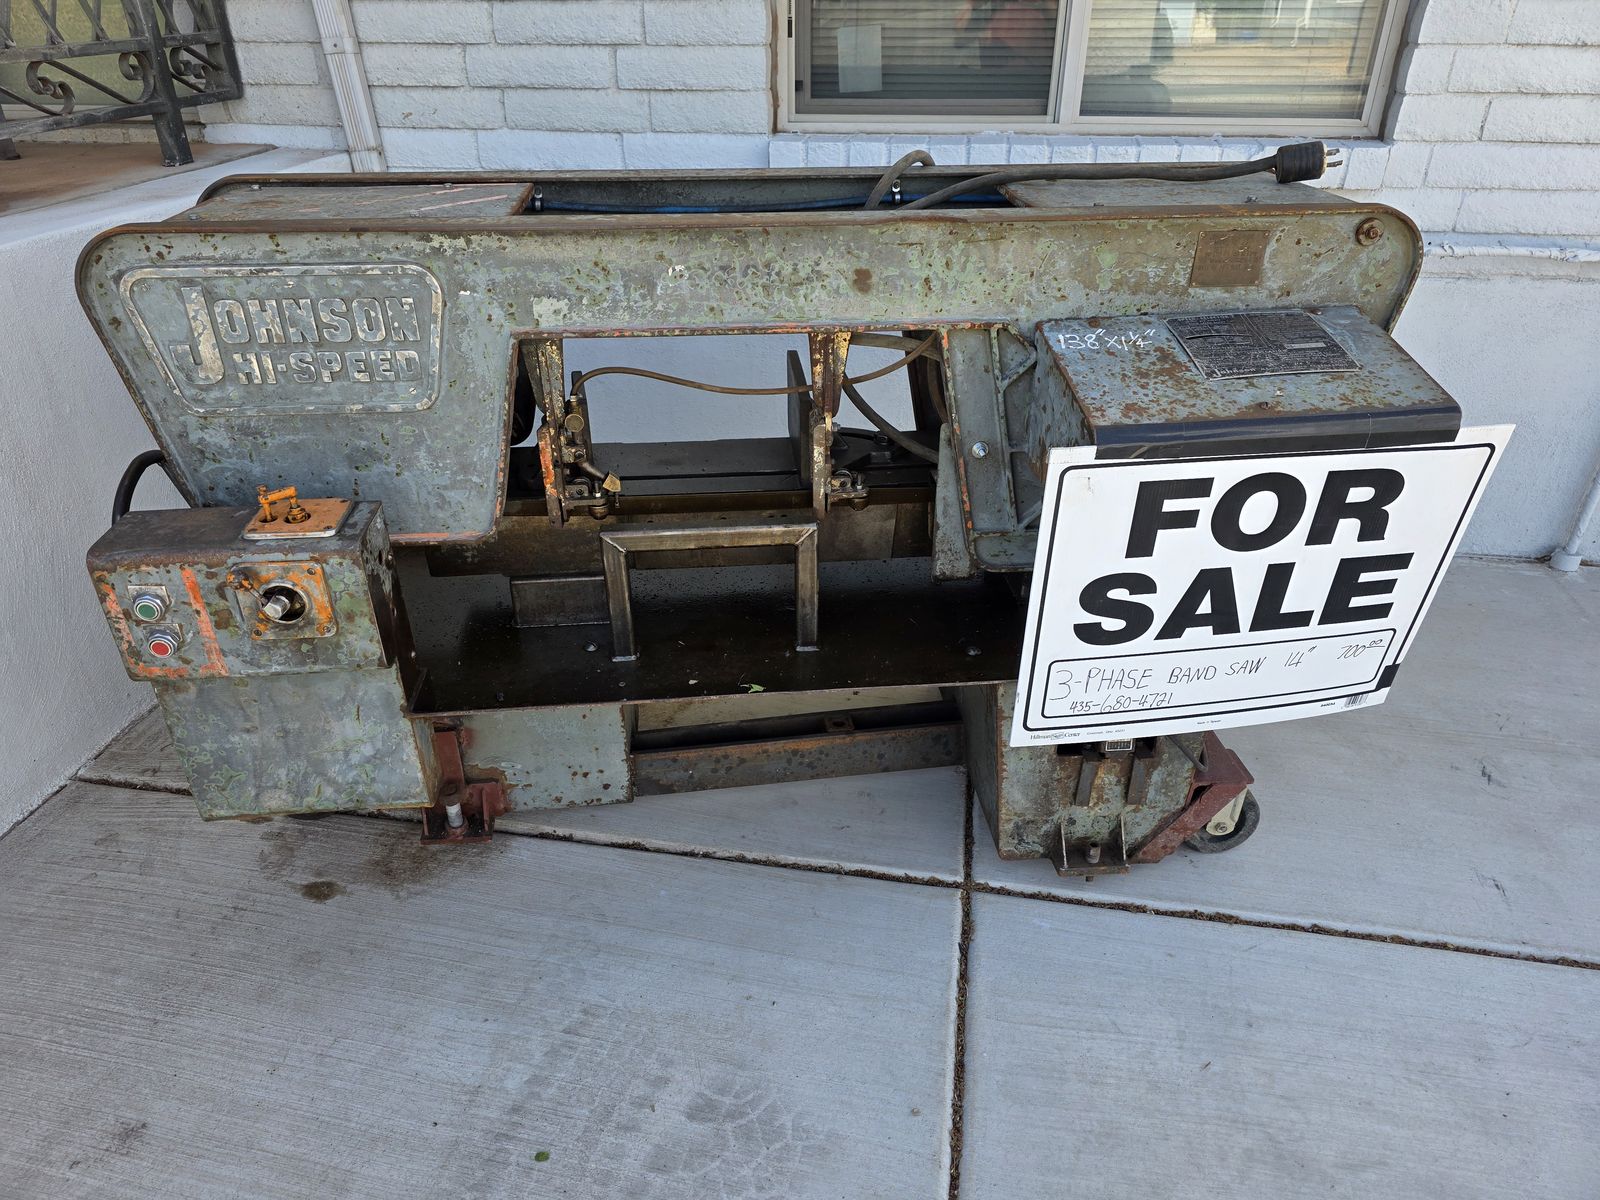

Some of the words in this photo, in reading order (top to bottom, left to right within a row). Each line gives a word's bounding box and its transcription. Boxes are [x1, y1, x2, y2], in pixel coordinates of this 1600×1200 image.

[169, 286, 421, 385] JOHNSON
[1125, 468, 1405, 559] FOR
[1073, 552, 1415, 646] SALE
[1049, 667, 1153, 701] 3-PHASE
[1166, 665, 1218, 685] BAND
[1225, 656, 1267, 676] SAW
[1069, 692, 1174, 714] 435-680-4721
